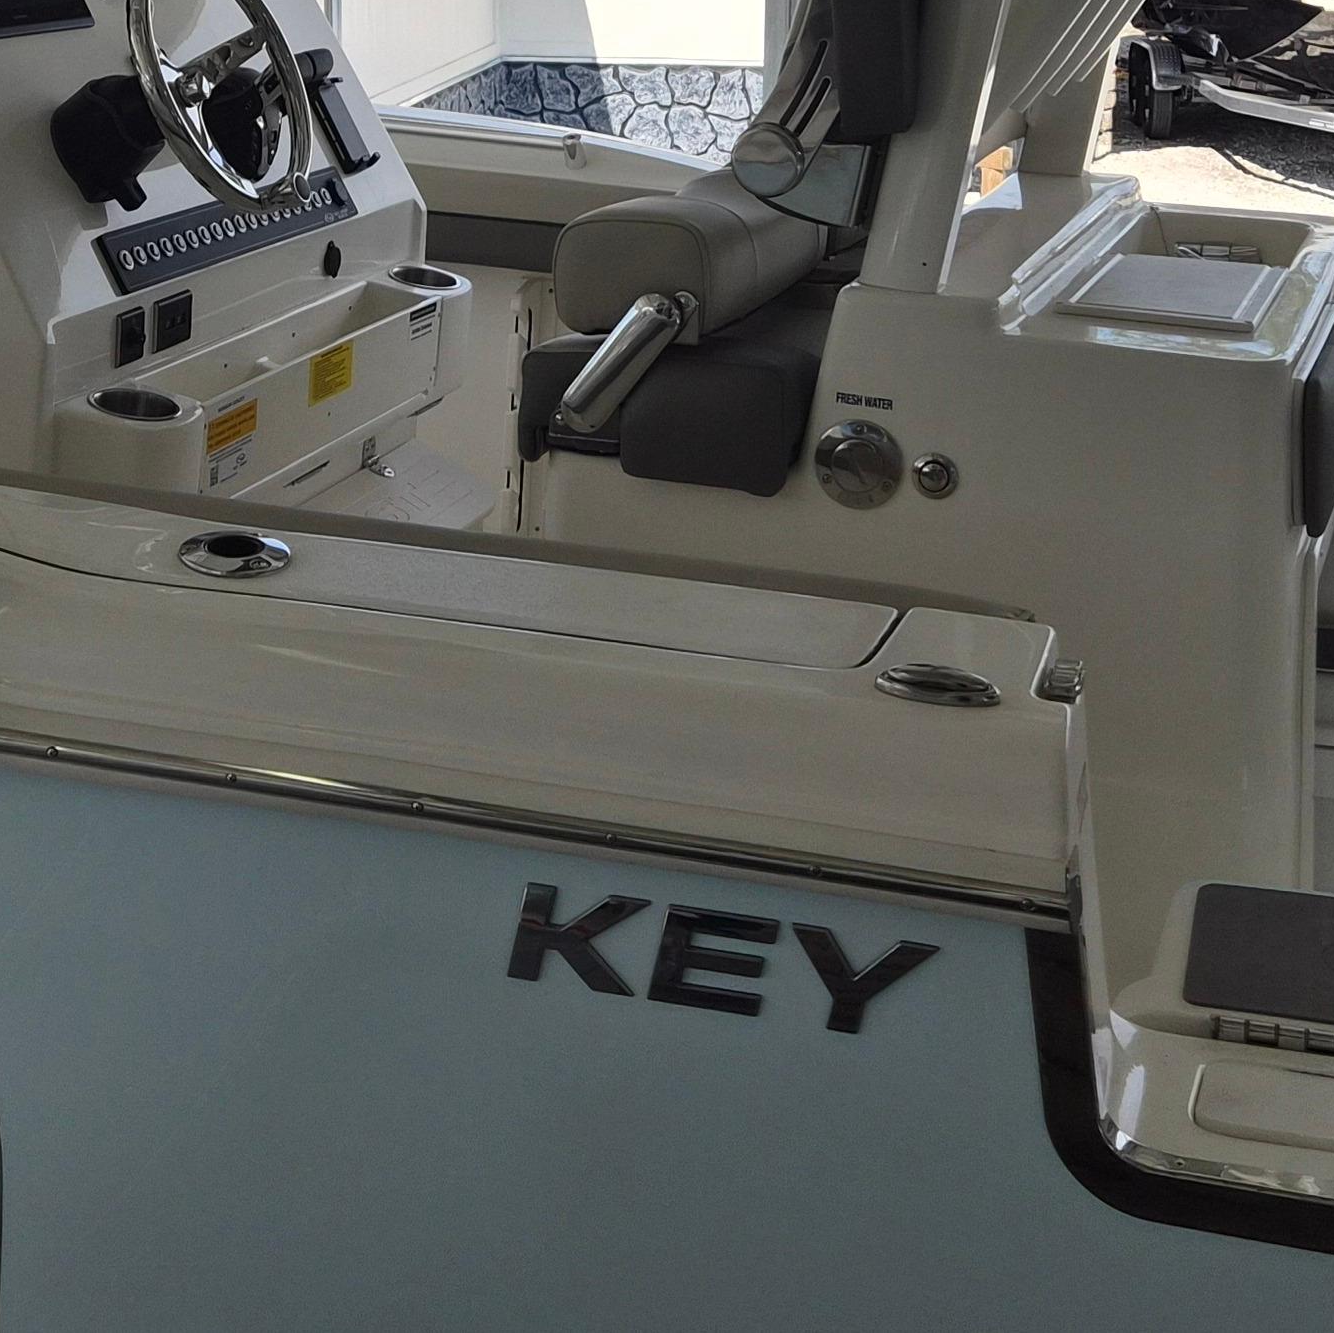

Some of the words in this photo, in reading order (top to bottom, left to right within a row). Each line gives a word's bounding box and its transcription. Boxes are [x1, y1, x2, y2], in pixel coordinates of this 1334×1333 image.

[836, 392, 863, 406] FRESH
[864, 396, 893, 411] WATER
[507, 882, 941, 1035] KEY
